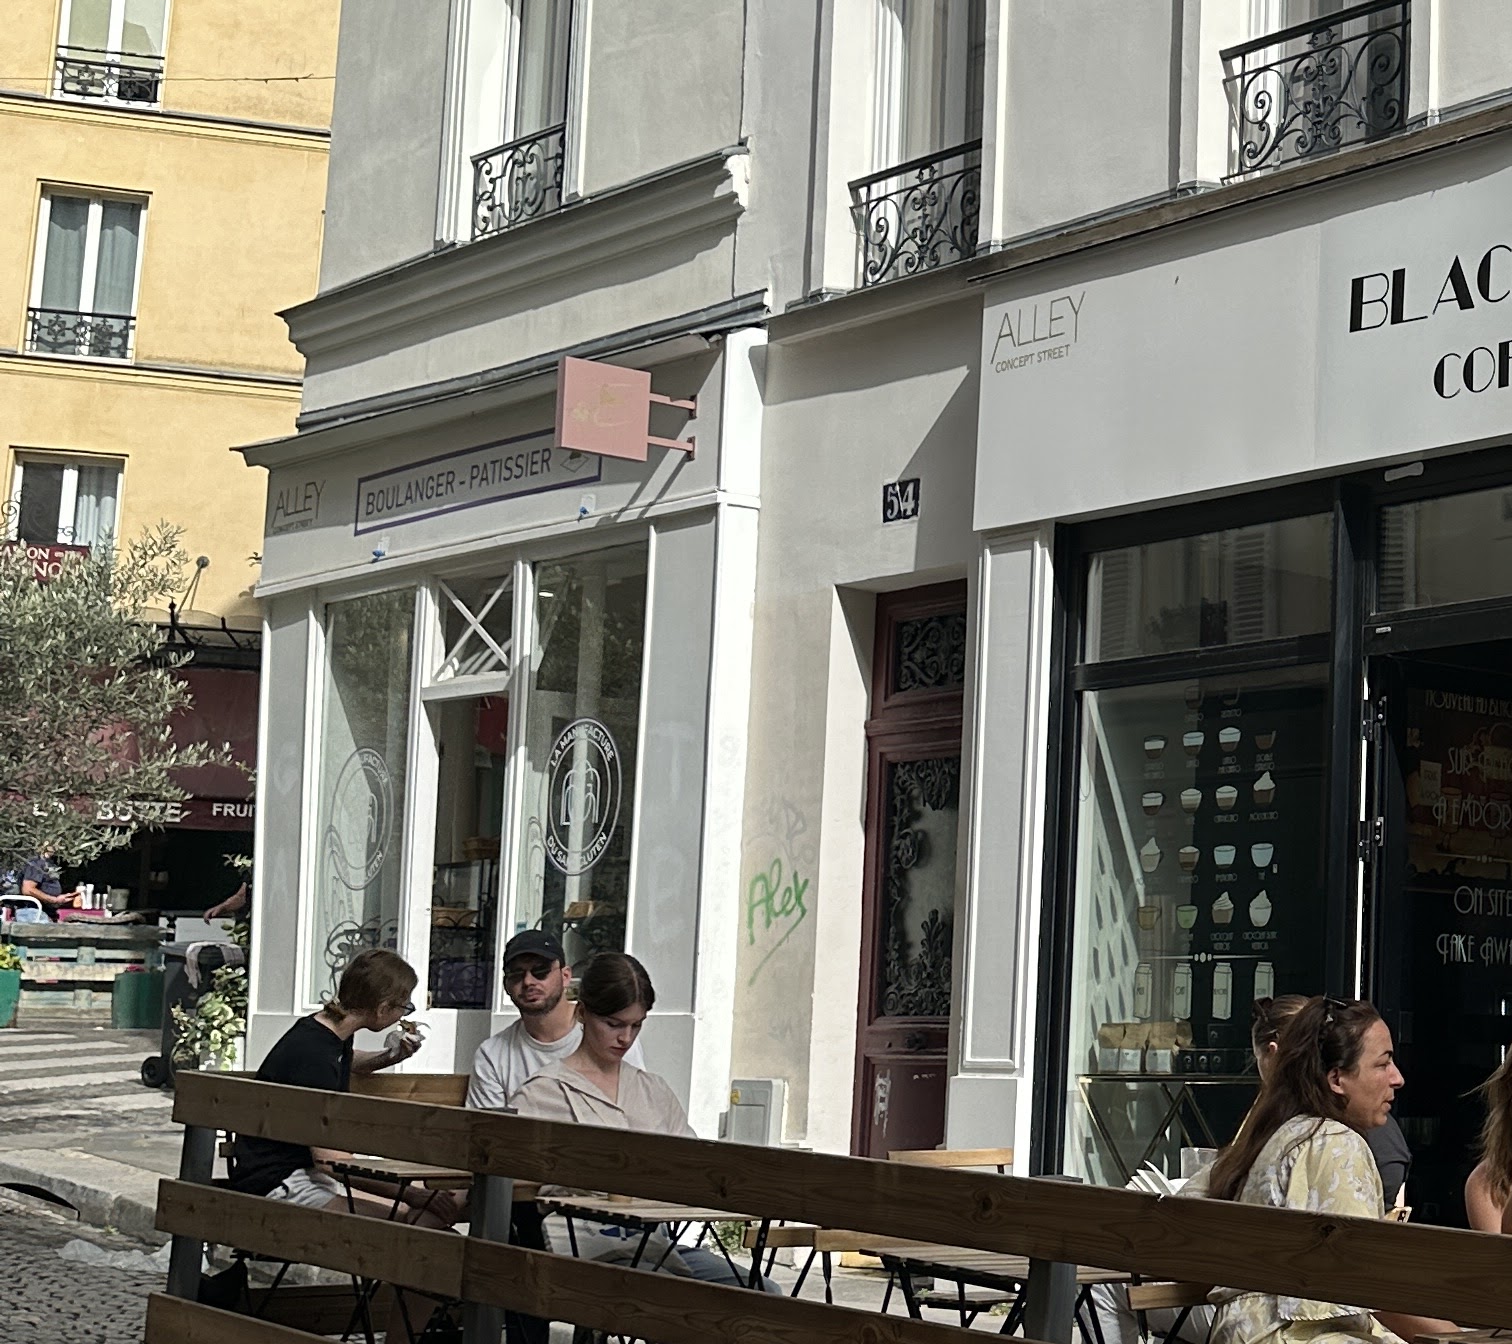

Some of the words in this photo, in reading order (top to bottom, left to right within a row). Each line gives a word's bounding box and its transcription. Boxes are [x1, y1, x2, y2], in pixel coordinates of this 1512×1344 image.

[990, 291, 1086, 365] ALLEY
[995, 353, 1035, 374] CONCEPT
[1037, 344, 1071, 364] STREET
[365, 470, 455, 516] BOULANGER
[469, 447, 552, 491] PATISSIER
[271, 479, 327, 529] ALLEY
[886, 482, 915, 519] 54
[1447, 746, 1471, 776] SUR
[212, 803, 256, 818] FRUI
[1453, 885, 1483, 915] ON
[1487, 887, 1512, 917] SITE
[1436, 933, 1475, 966] TAKE
